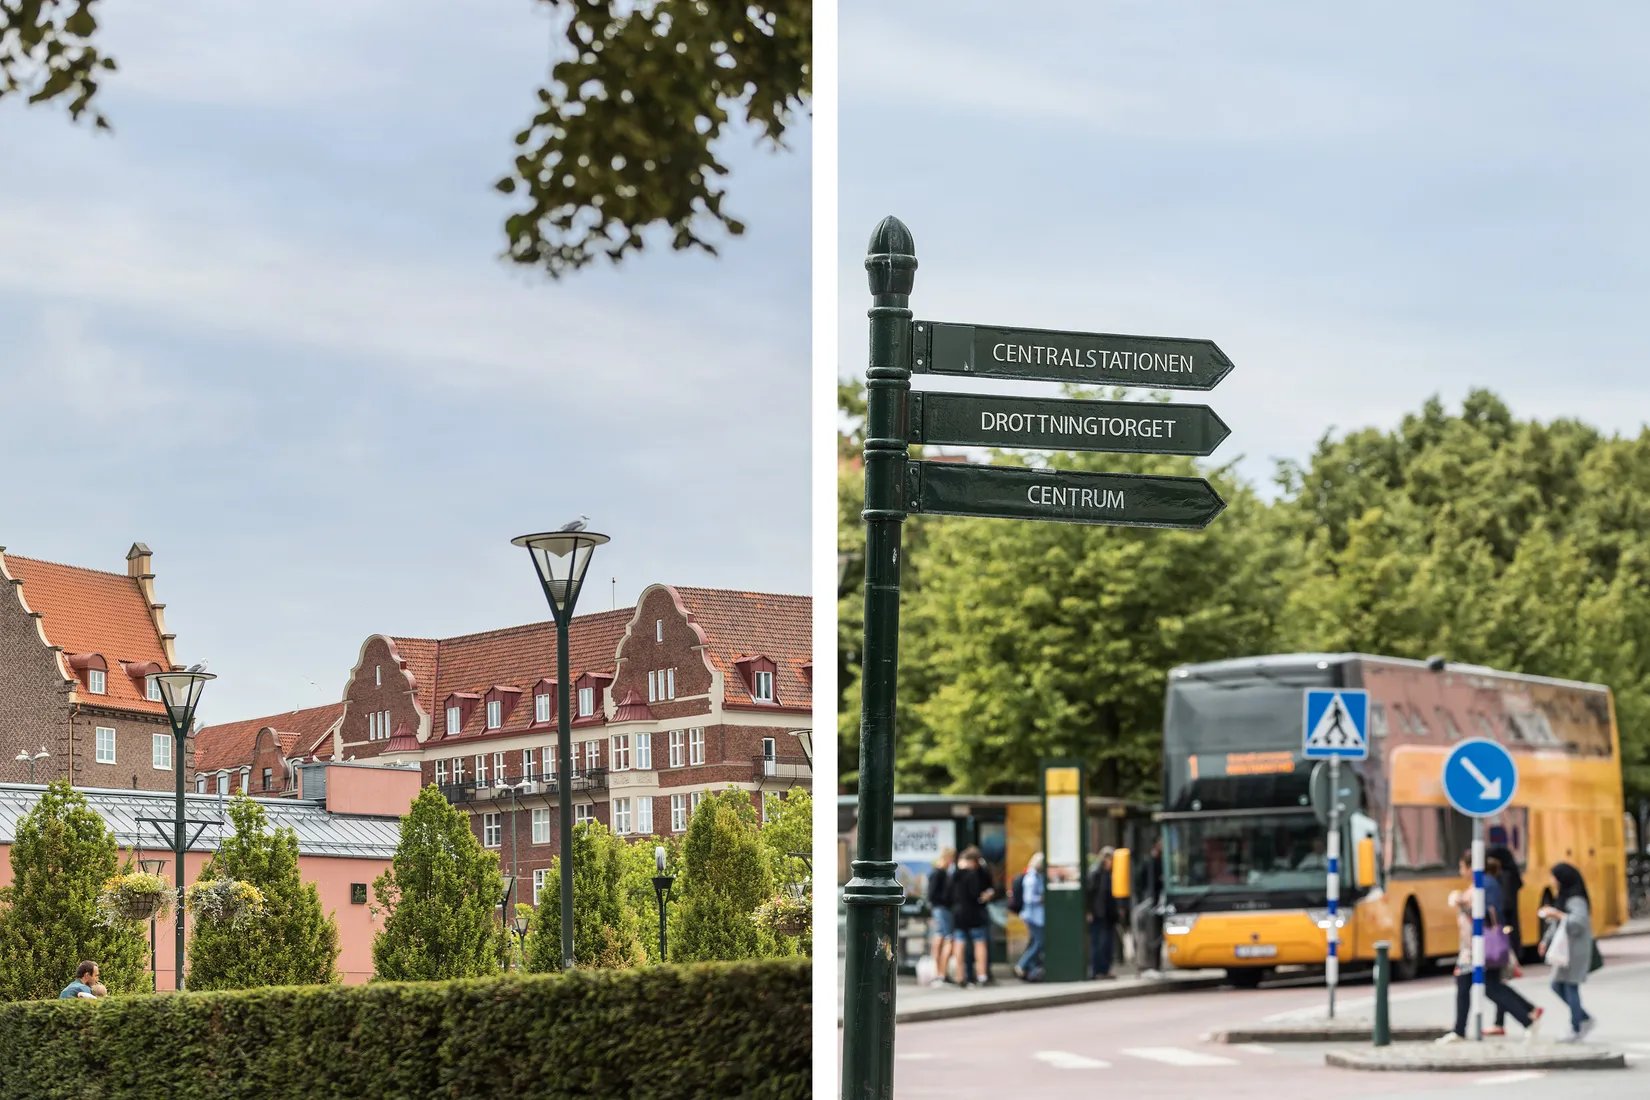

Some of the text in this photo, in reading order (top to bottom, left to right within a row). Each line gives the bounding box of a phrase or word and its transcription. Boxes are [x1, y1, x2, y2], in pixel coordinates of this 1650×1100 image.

[992, 343, 1194, 373] CENTRALSTATIONEN
[981, 411, 1176, 438] DROTTNINGTORGET
[1027, 485, 1125, 509] CENTRUM
